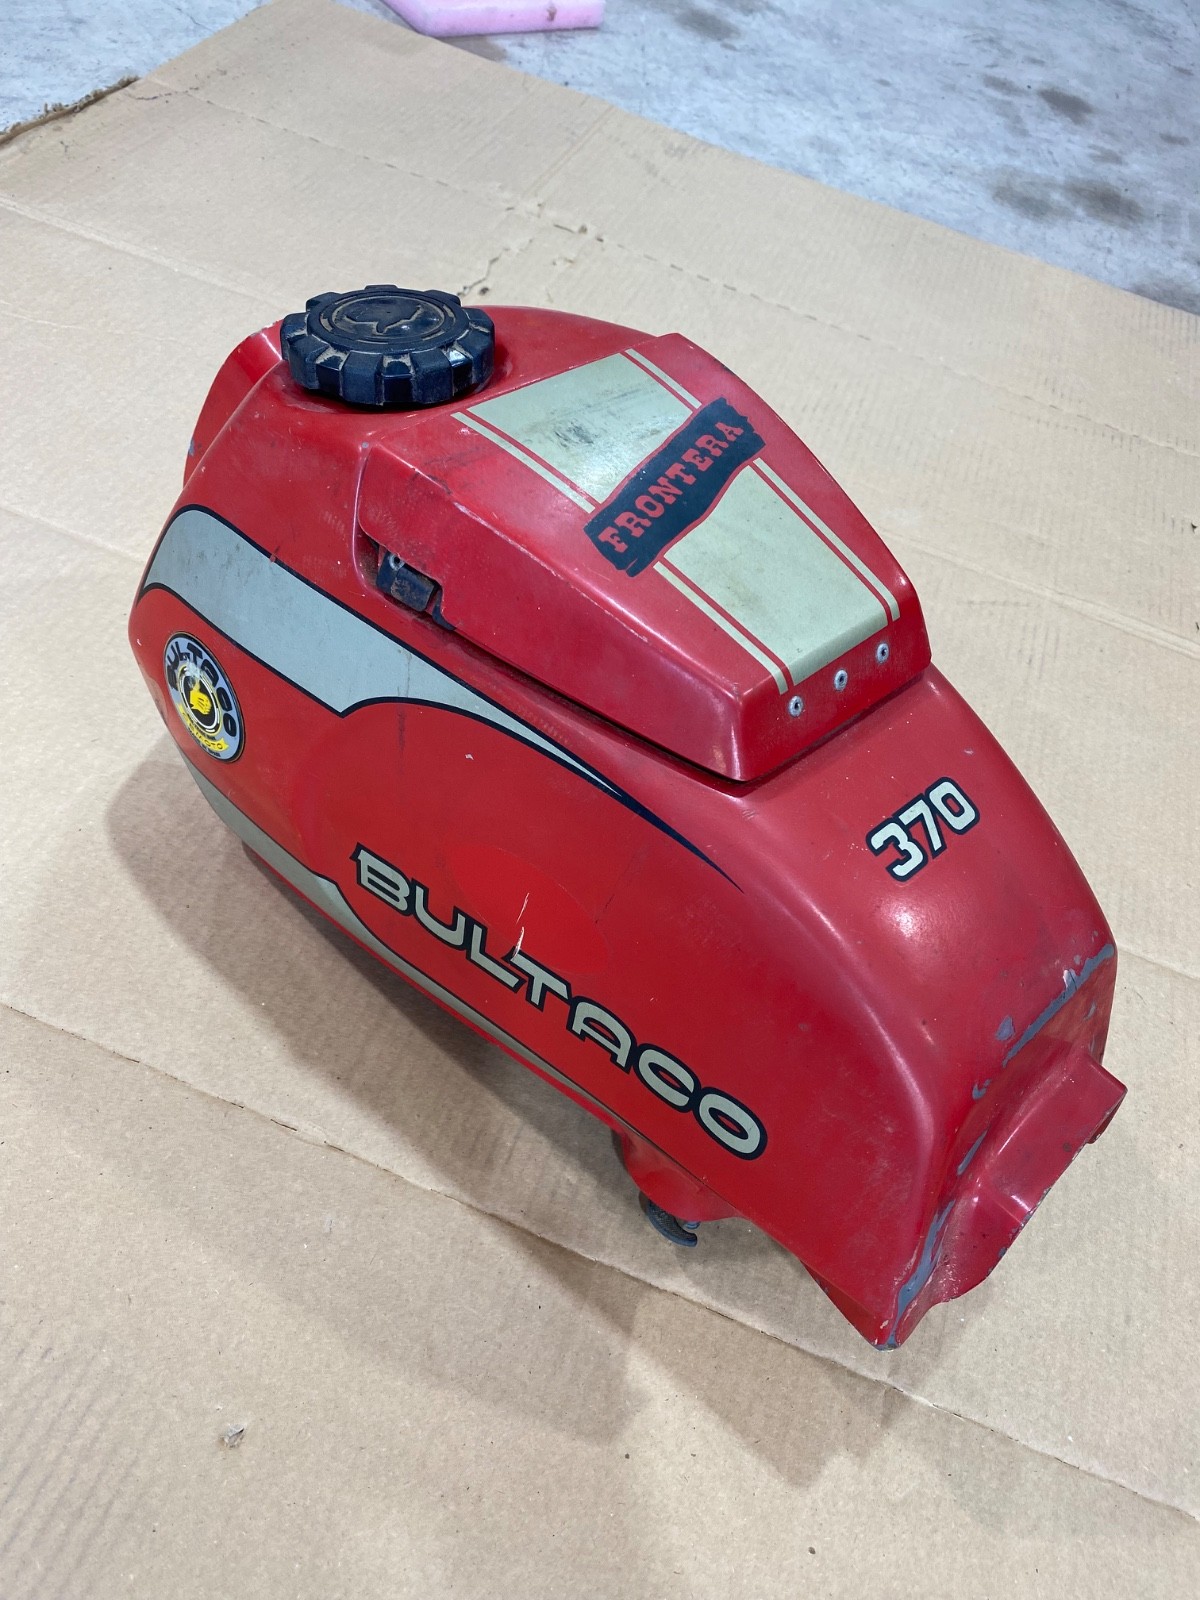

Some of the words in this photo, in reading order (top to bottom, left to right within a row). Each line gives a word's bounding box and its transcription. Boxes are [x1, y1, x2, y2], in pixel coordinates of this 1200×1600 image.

[597, 421, 744, 553] FRONTERA
[865, 776, 981, 883] 370
[350, 842, 768, 1161] BULTACO
